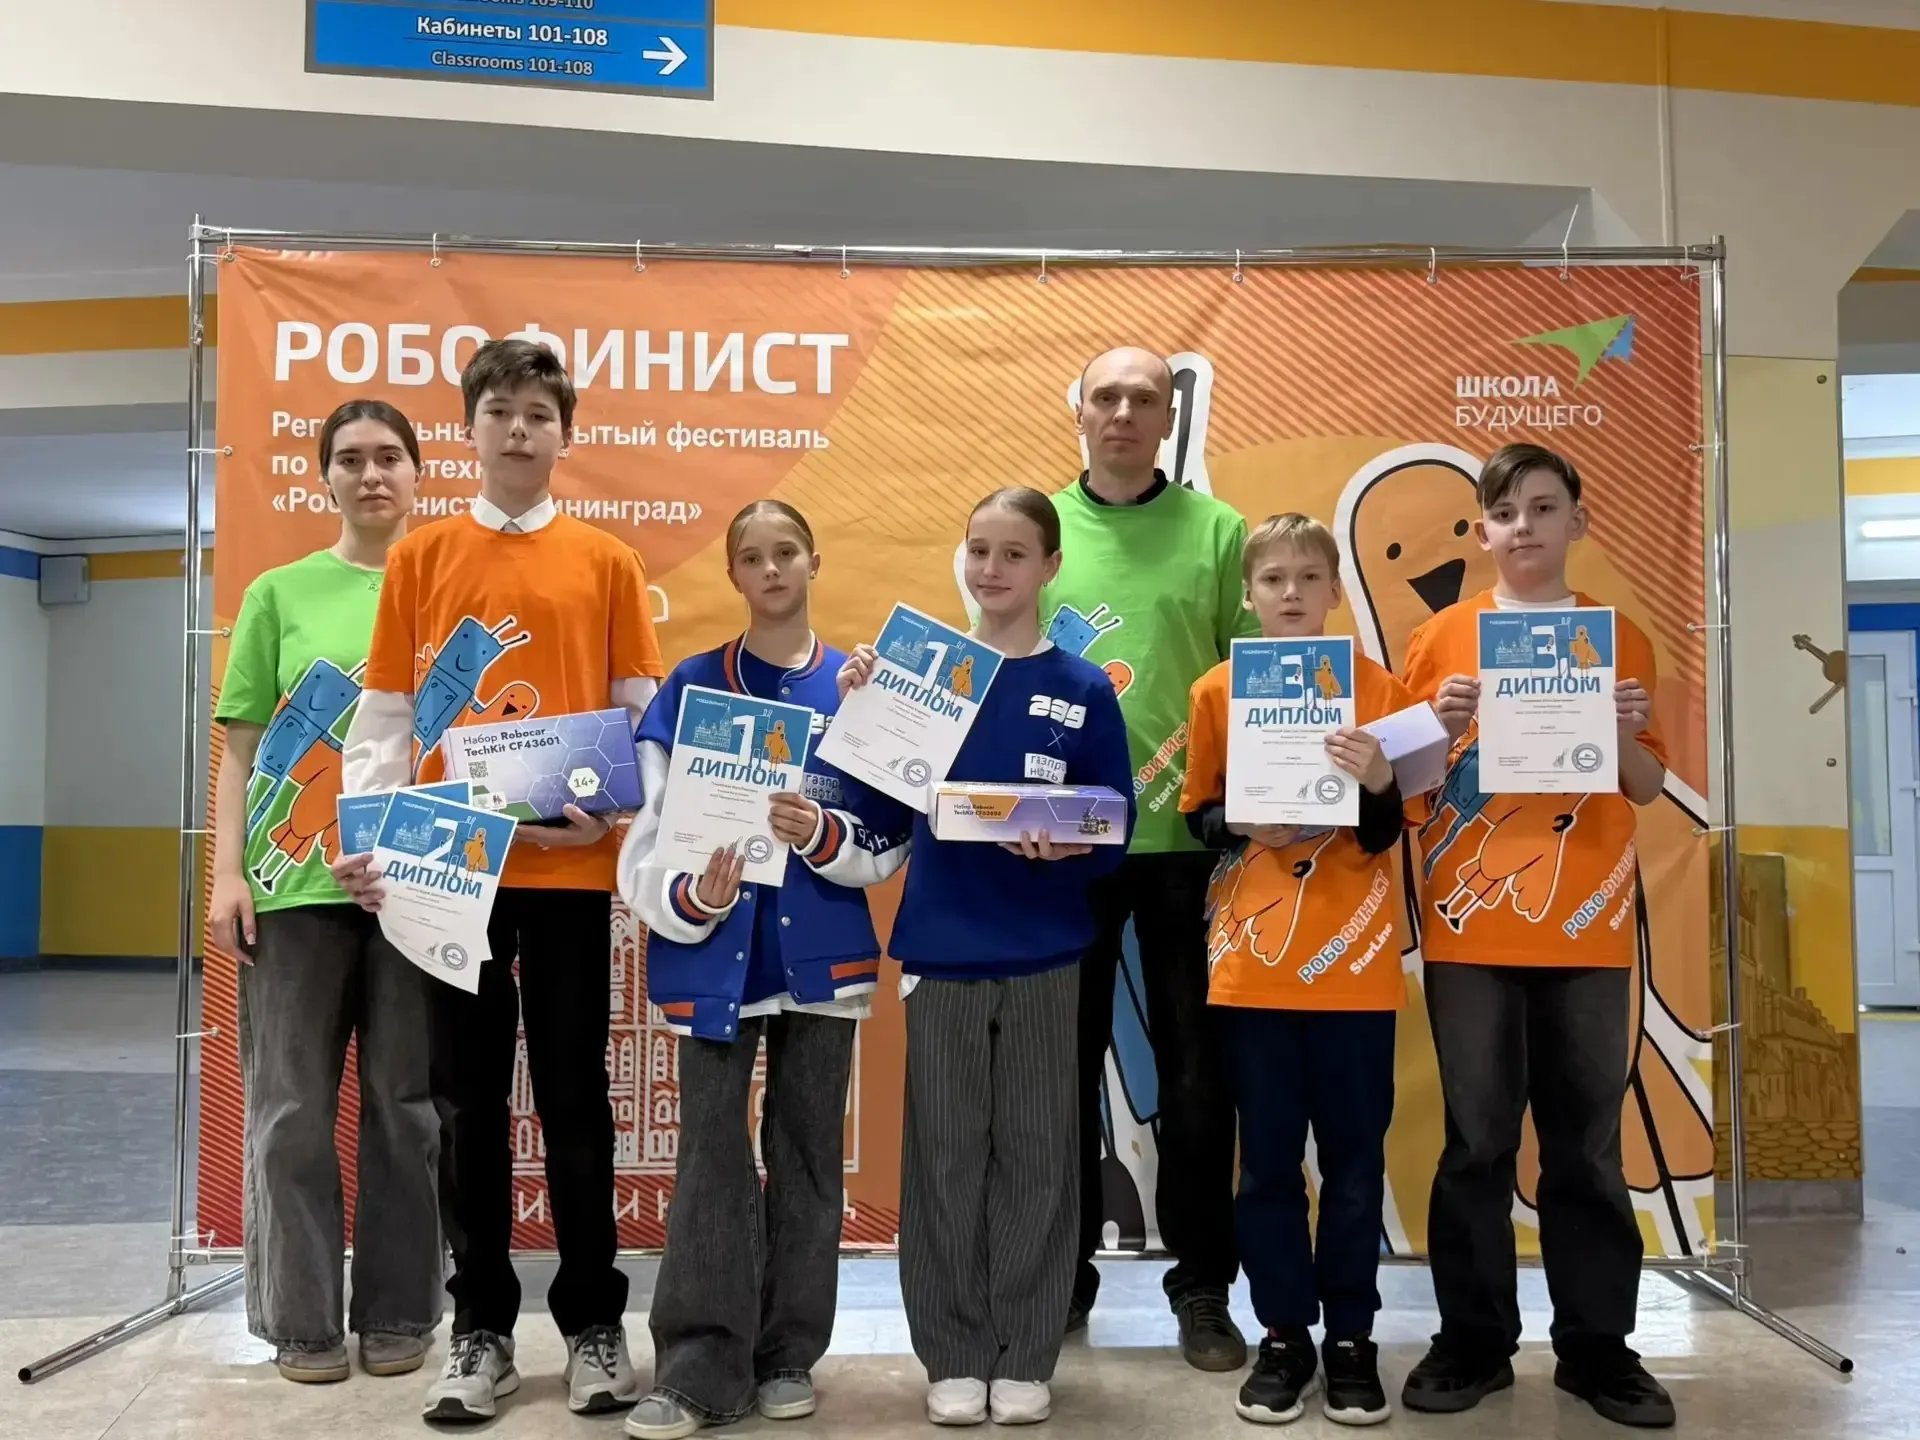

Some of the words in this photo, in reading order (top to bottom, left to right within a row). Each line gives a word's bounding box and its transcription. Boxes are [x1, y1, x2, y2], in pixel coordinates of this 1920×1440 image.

[417, 16, 521, 40] Кабинеты
[528, 24, 609, 46] 101-108
[431, 51, 524, 71] Classrooms
[528, 57, 593, 75] 101-108
[274, 320, 849, 394] РОБОИНИСТ
[1456, 376, 1560, 398] ШКОЛА
[1456, 404, 1602, 432] БУДУЩЕГО
[666, 421, 830, 452] фестиваль
[272, 455, 308, 475] по
[872, 668, 963, 722] ДИПЛОМ
[1496, 675, 1600, 698] ДИПЛОМ
[1029, 695, 1087, 729] 239
[1245, 706, 1342, 727] ДИПЛОМ
[463, 735, 498, 745] Набор
[500, 728, 546, 741] Robocar
[465, 745, 506, 757] TechKit
[509, 736, 560, 751] CF43601
[574, 778, 595, 788] 14+
[687, 757, 787, 789] ДИПЛОМ
[382, 859, 483, 899] ДИПЛОМ
[1297, 868, 1390, 984] РОБОФИНИСТ
[1349, 922, 1393, 975] StarLine
